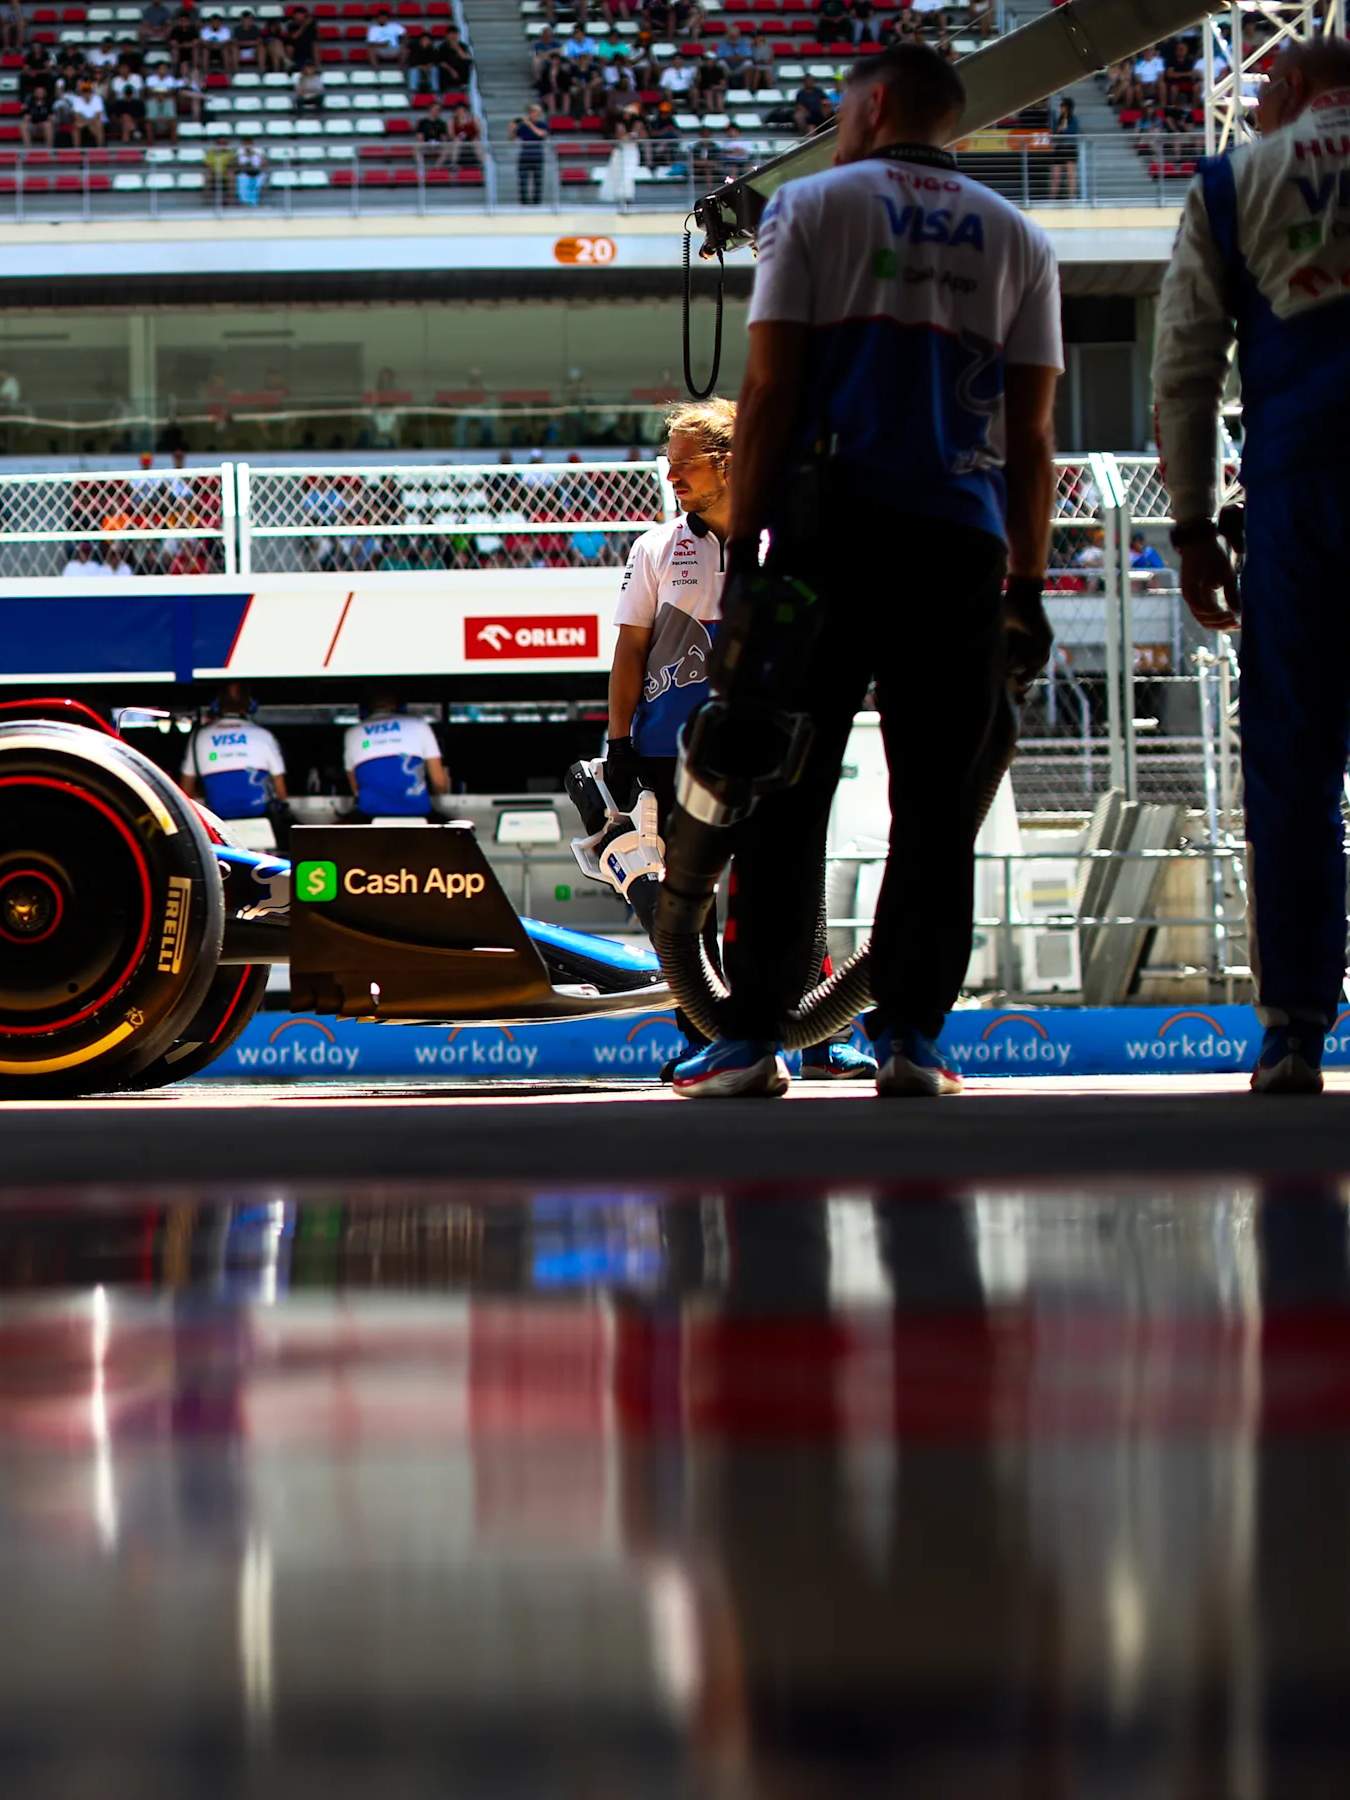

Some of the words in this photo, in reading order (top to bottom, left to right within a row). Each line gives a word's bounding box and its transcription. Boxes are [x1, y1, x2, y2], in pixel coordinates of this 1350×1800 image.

[875, 195, 984, 252] VISA
[575, 238, 612, 262] 20
[672, 579, 698, 587] TUDOR
[514, 627, 587, 647] ORLEN
[211, 733, 247, 747] VISA
[364, 721, 401, 736] VISA
[344, 868, 418, 895] Cash
[423, 867, 485, 899] App
[157, 876, 192, 975] PIRELLI
[236, 1041, 360, 1069] workday
[414, 1039, 539, 1068] workday
[593, 1039, 683, 1065] workd
[951, 1037, 1072, 1065] workday
[1126, 1034, 1248, 1063] workday
